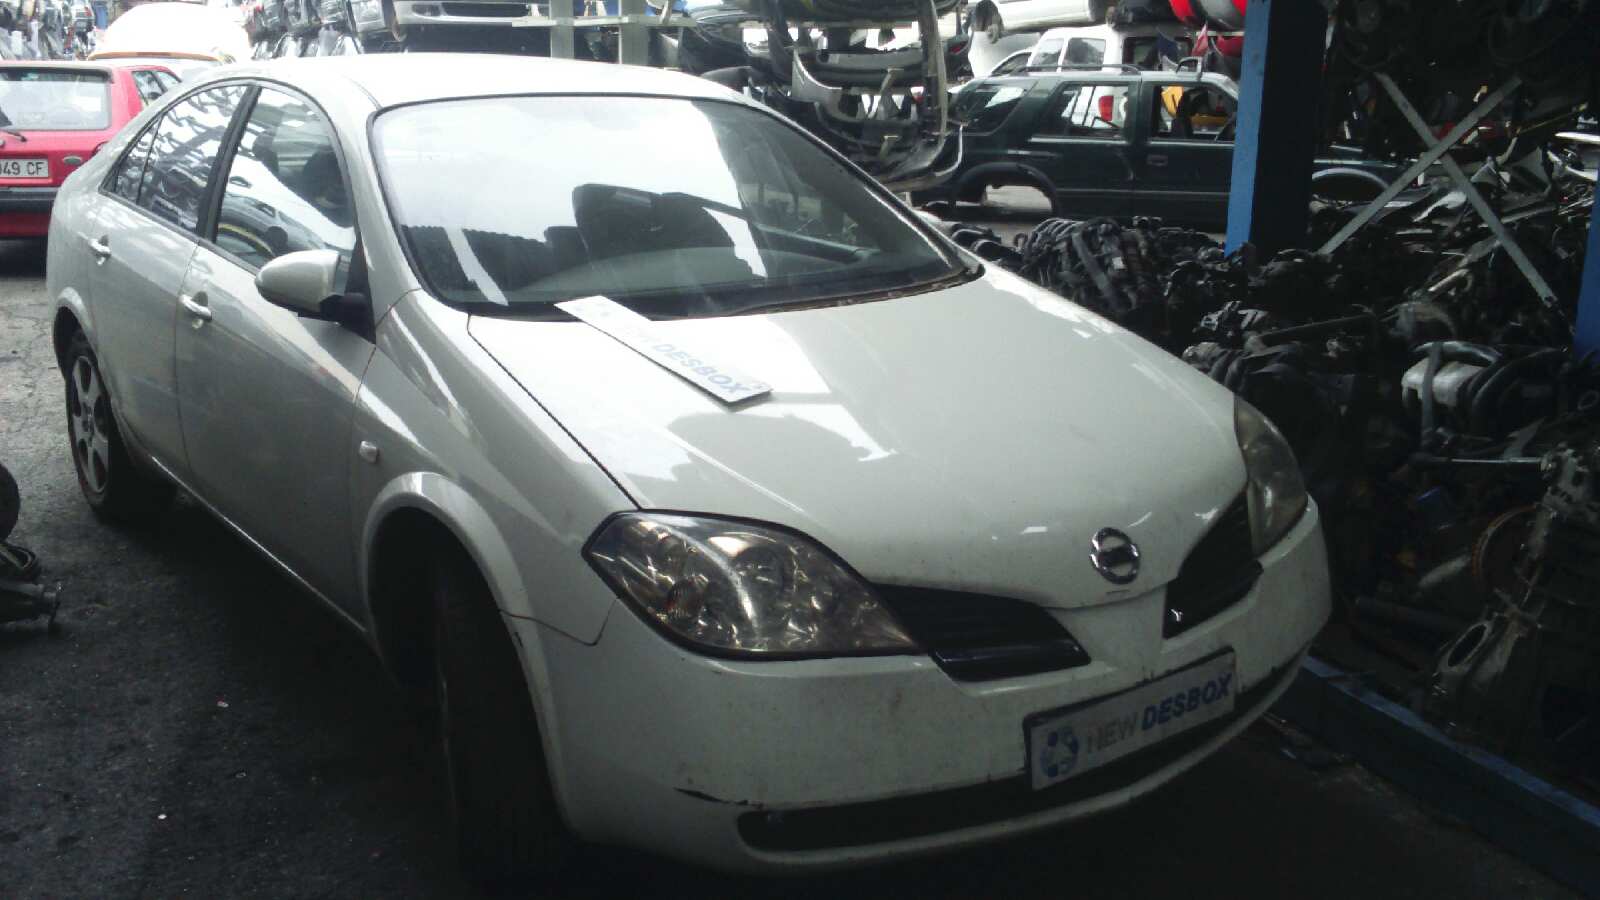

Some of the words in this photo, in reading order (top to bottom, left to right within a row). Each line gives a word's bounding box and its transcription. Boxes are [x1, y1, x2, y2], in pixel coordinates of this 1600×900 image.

[0, 161, 20, 175] 49
[27, 161, 44, 175] CF
[652, 343, 752, 393] DESBOX
[1087, 711, 1137, 752] NEW
[1141, 672, 1233, 731] DESBOX
